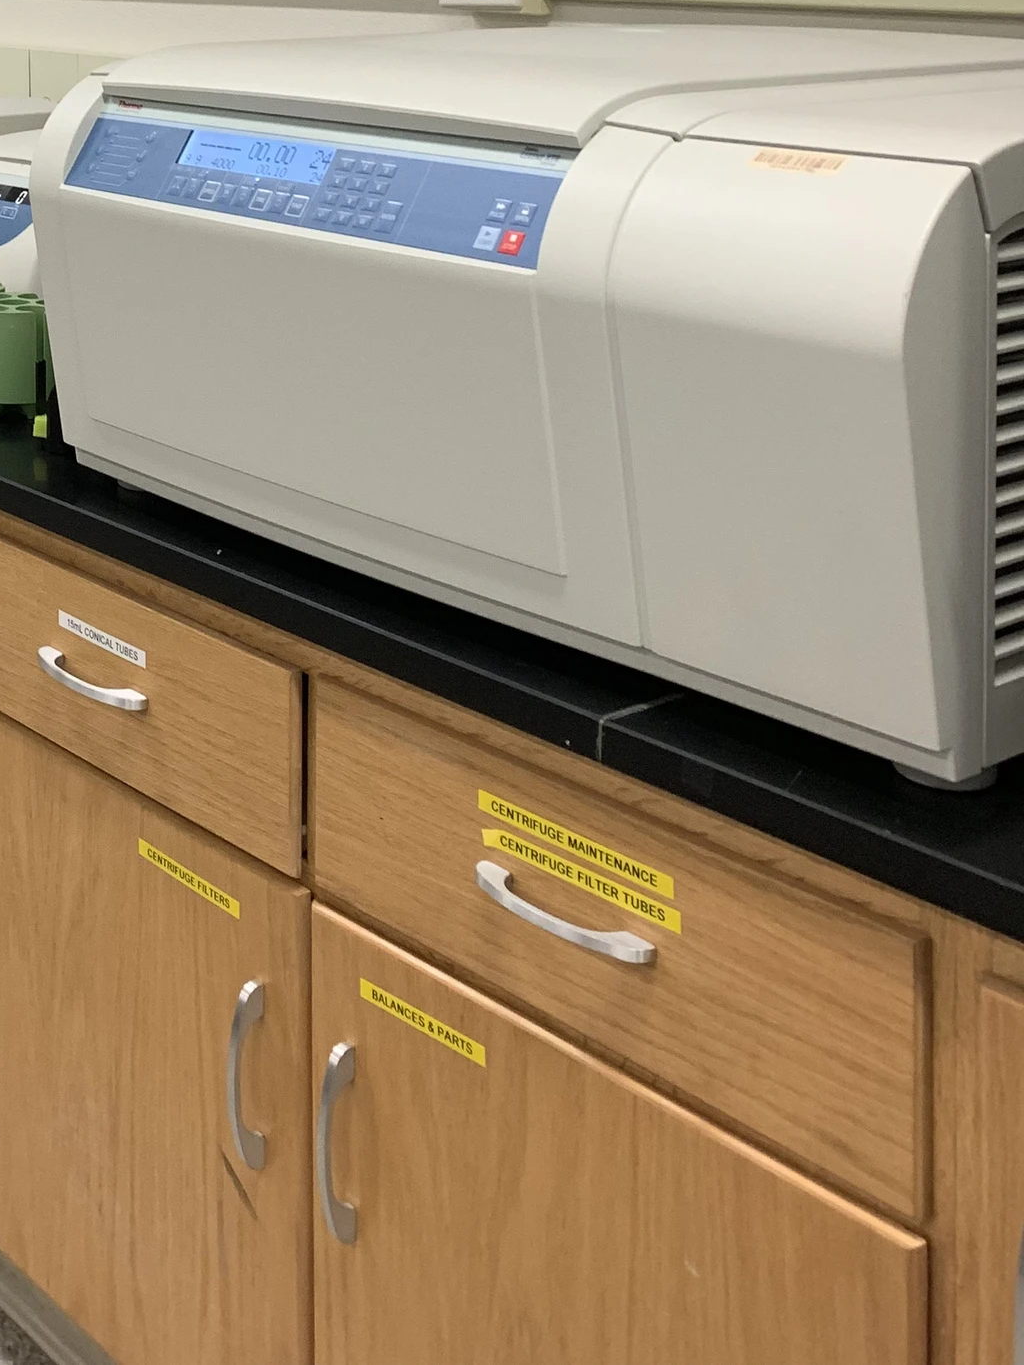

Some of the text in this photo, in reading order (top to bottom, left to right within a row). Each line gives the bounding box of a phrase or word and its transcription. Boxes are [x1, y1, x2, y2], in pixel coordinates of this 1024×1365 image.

[211, 157, 236, 171] 4000
[247, 141, 297, 165] 00.00
[15, 190, 28, 205] 0
[67, 618, 139, 661] 15mL CONICAL TUBES
[491, 799, 658, 888] CENTRIFUGE MAINTENANCE
[147, 848, 230, 909] CENTRIFUGE FILTERS
[499, 834, 666, 923] CENTRIFUGE FILTER TUBES
[371, 988, 474, 1056] BALANCES & PARTS
